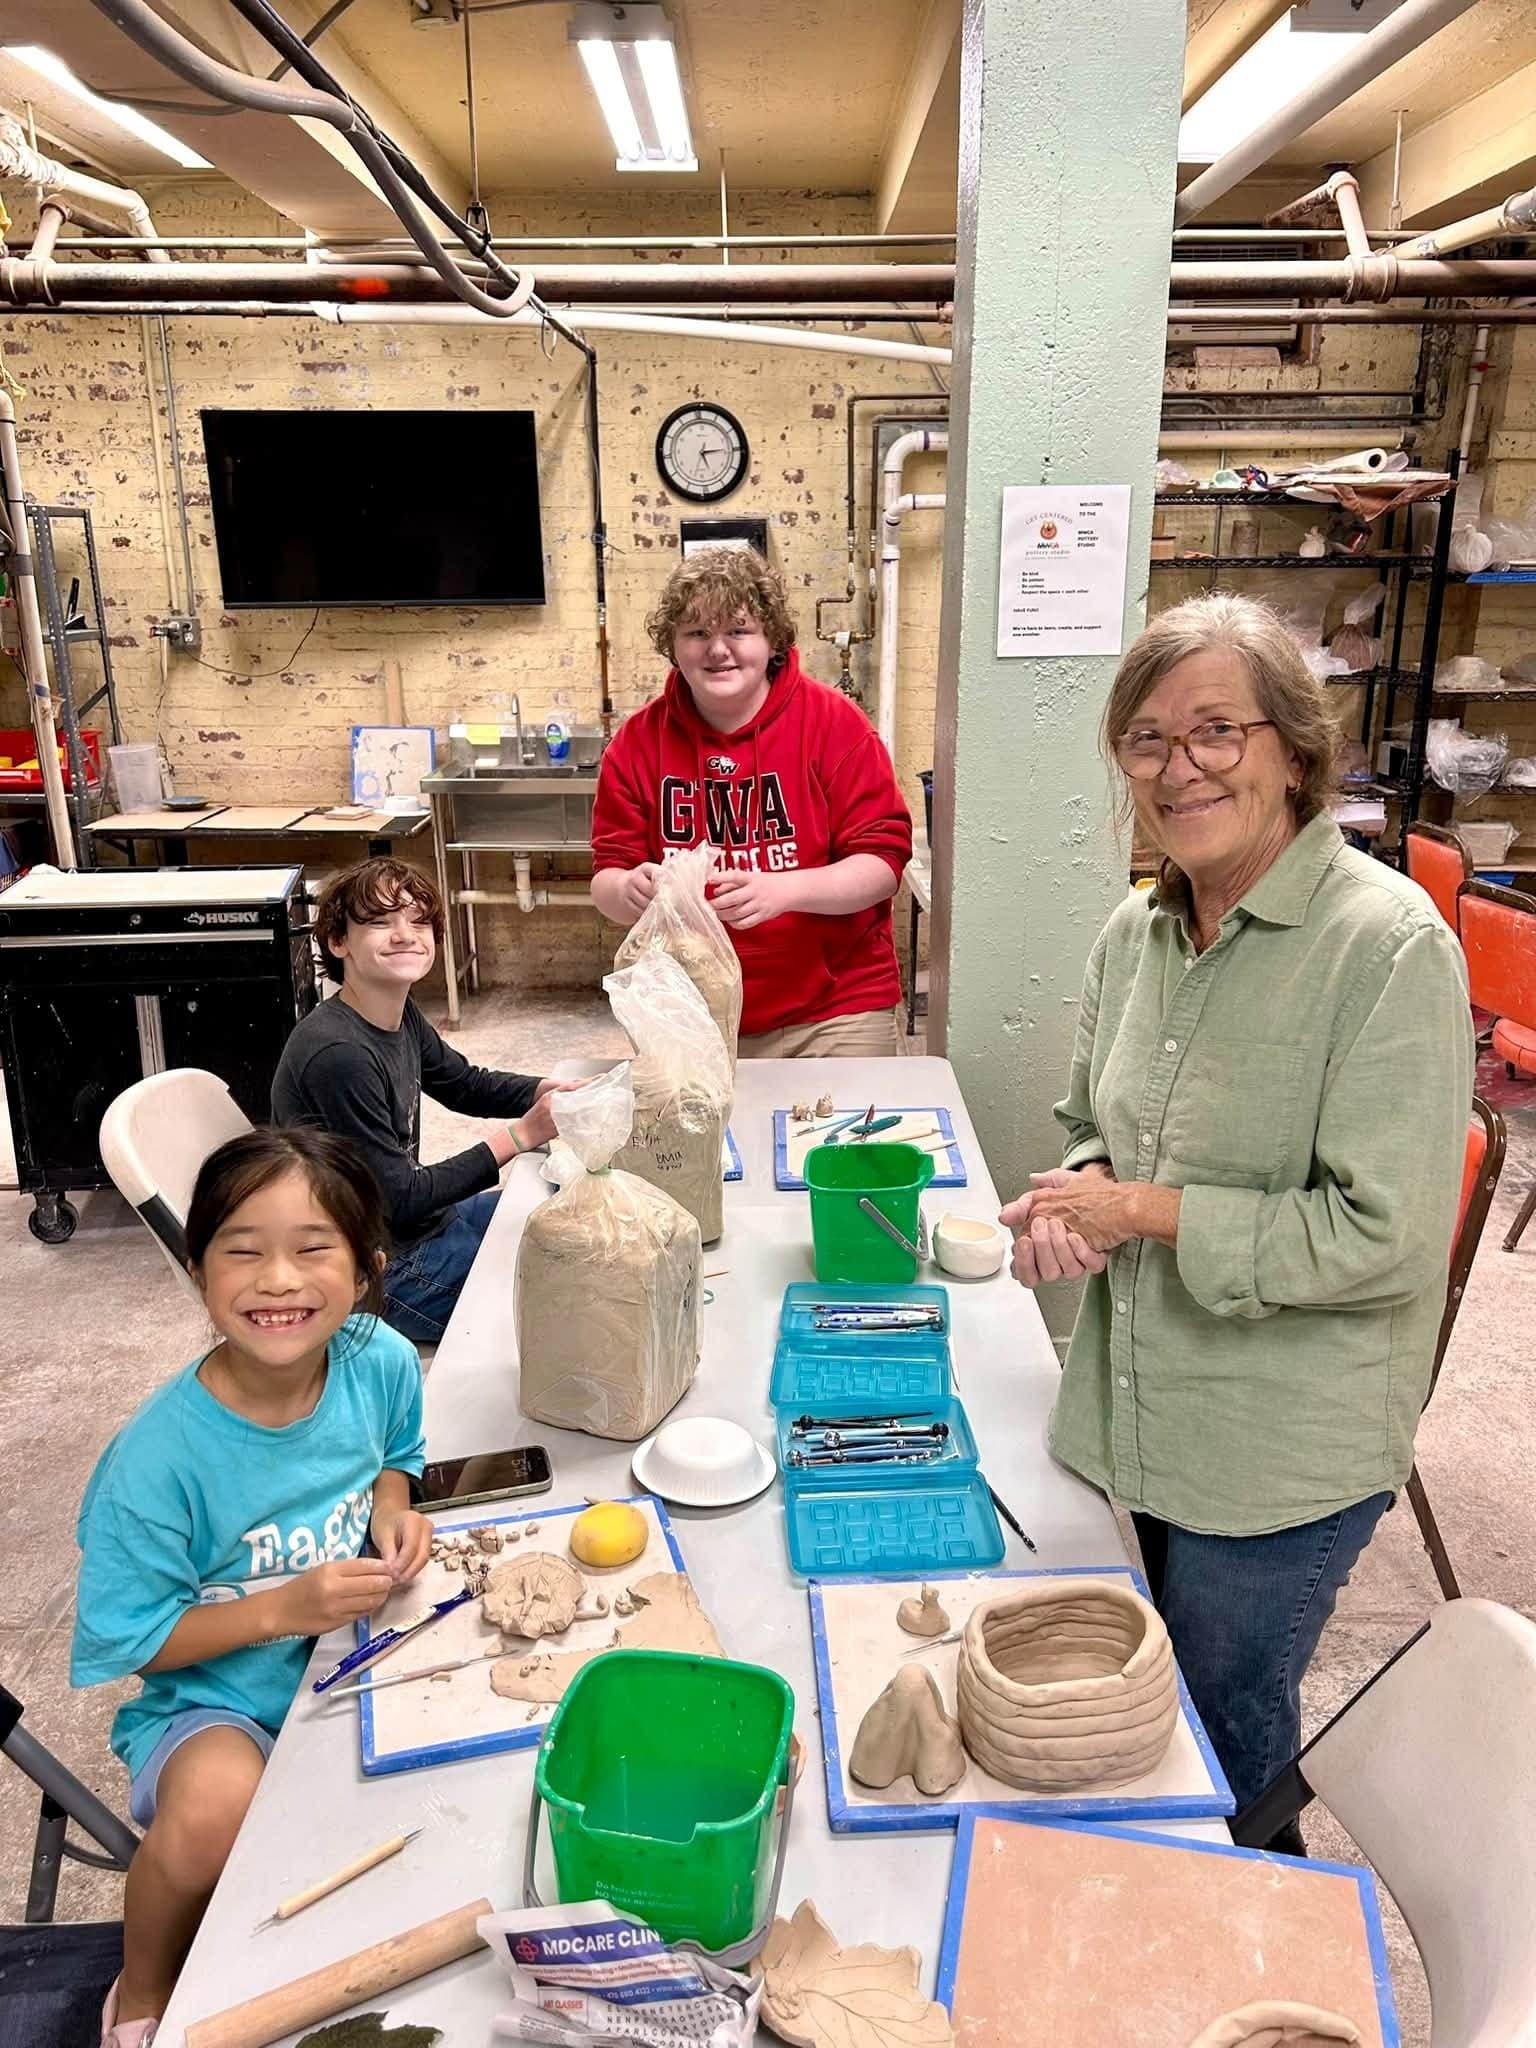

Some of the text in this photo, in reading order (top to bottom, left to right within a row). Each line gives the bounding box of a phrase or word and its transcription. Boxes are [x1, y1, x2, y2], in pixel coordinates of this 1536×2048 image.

[661, 772, 796, 847] GWA
[206, 911, 259, 924] HUSKY
[542, 1924, 663, 1956] MDCARE CLIN
